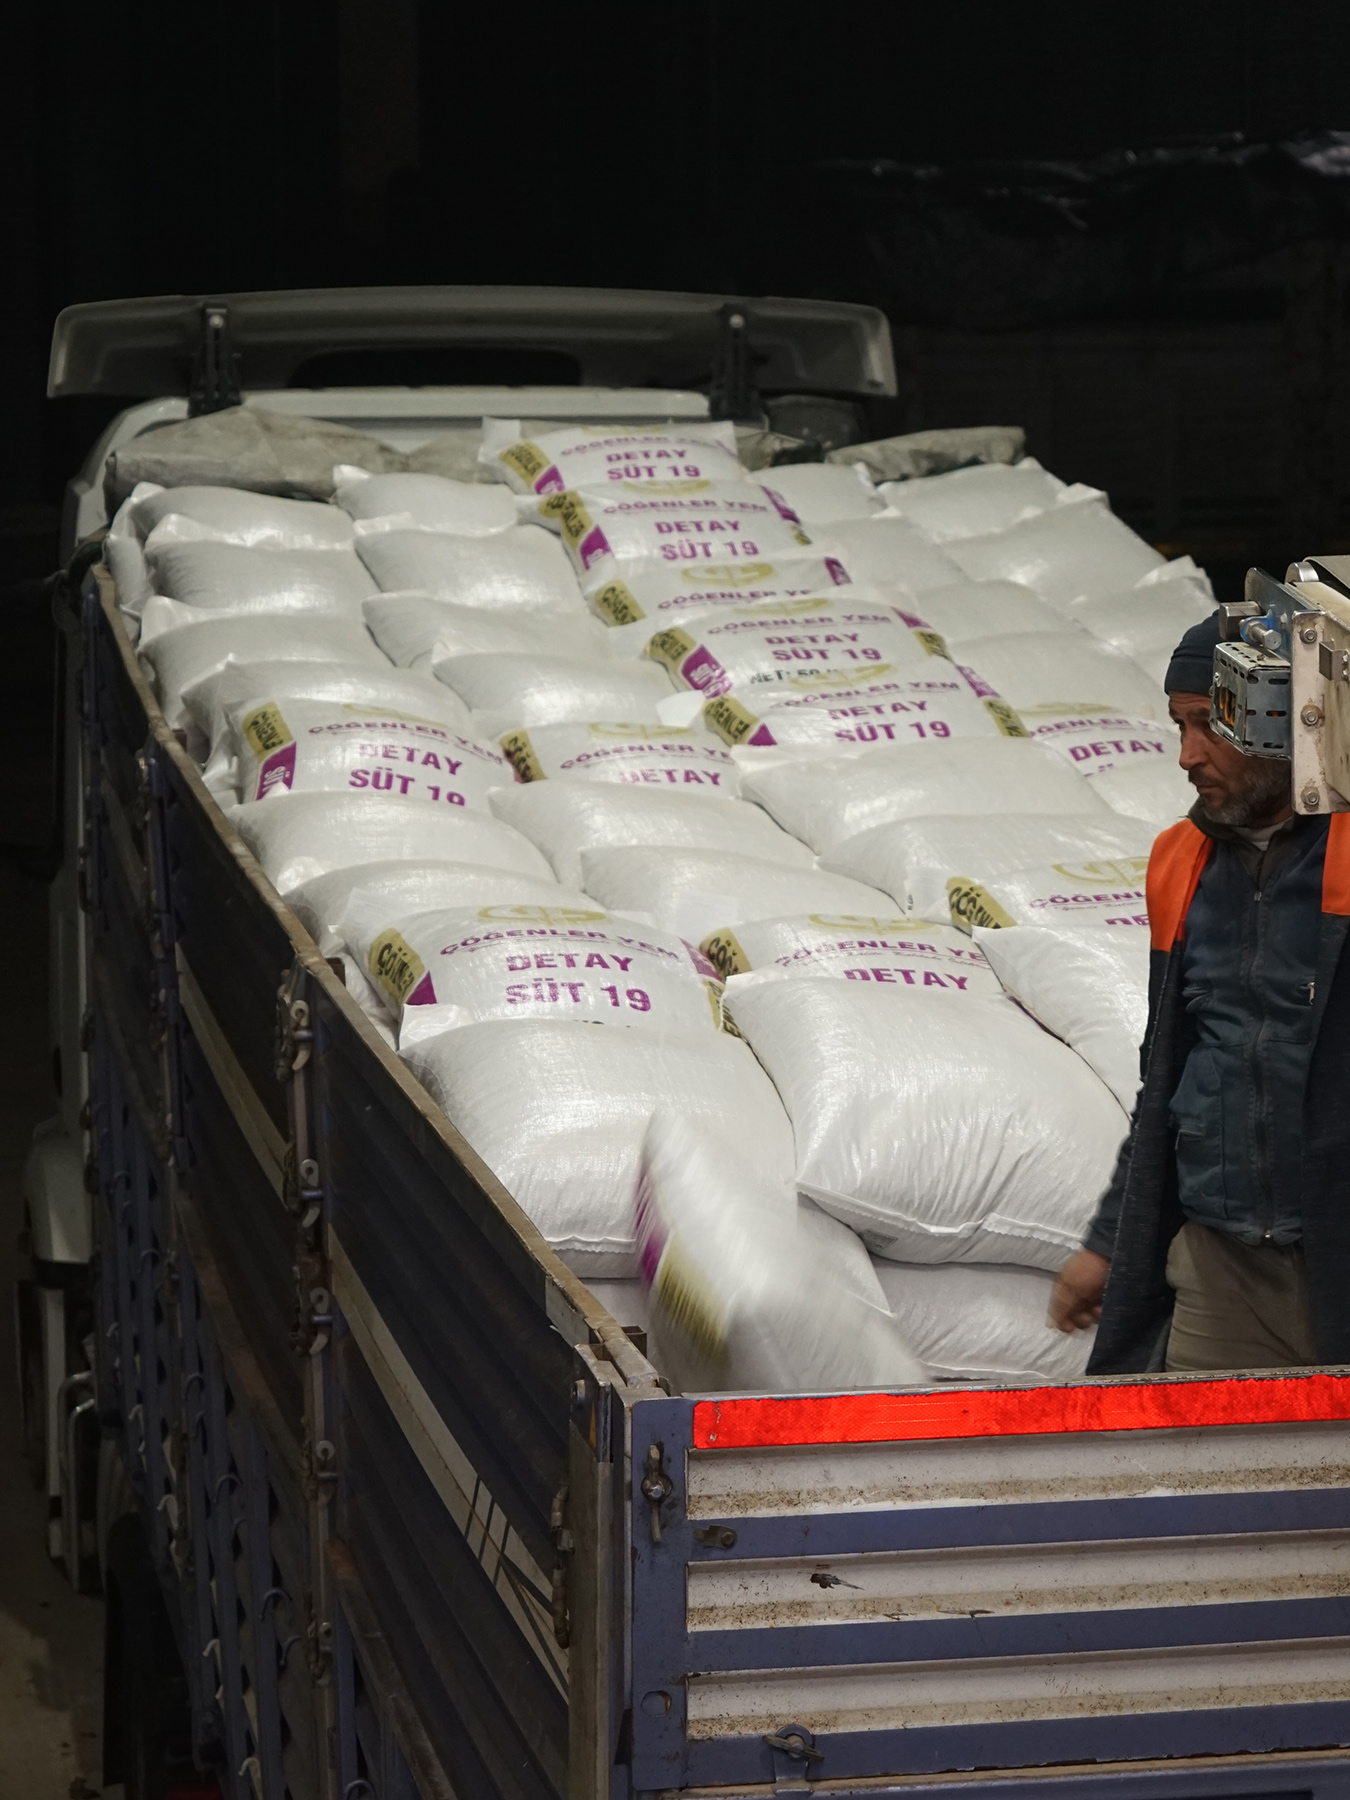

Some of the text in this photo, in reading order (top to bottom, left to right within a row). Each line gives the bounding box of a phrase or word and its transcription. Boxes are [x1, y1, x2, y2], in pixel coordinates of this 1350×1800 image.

[606, 449, 688, 462] DETAY
[607, 464, 700, 480] SÜT 19
[655, 520, 740, 534] DETAY
[660, 539, 759, 560] SÜT 19
[765, 633, 859, 645] DETAY
[842, 648, 882, 660] 19
[835, 720, 951, 742] SÜT 19
[359, 744, 462, 775] DETAY
[1068, 740, 1165, 761] DETAY
[349, 766, 415, 795] SÜT
[619, 769, 721, 786] DETAY
[505, 953, 633, 972] DETAY
[844, 967, 968, 990] DETAY
[505, 978, 651, 1012] SÜT 19
